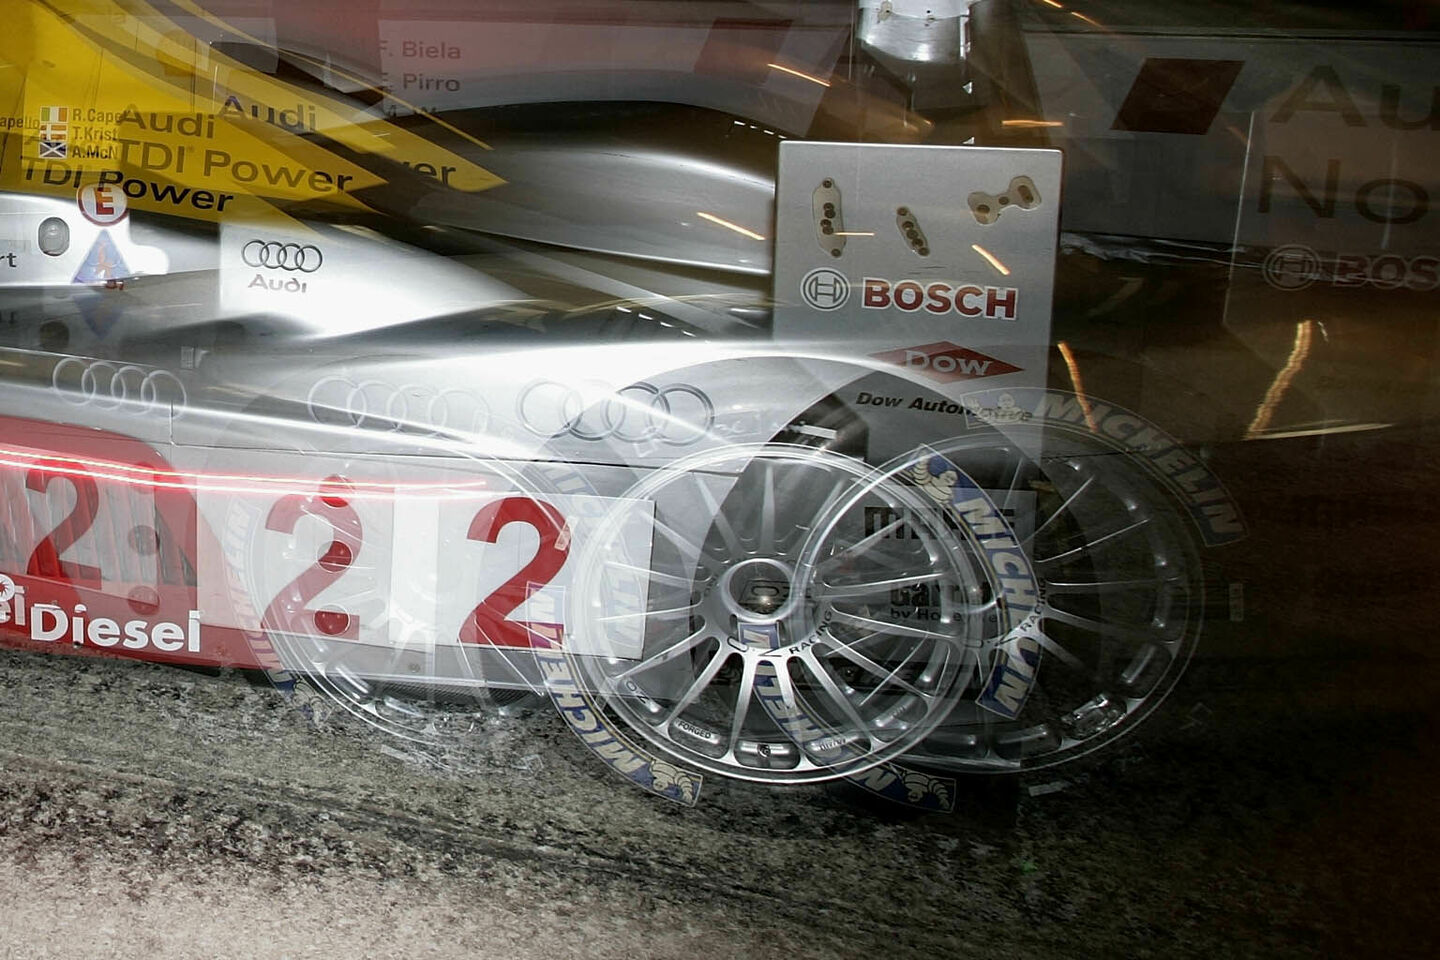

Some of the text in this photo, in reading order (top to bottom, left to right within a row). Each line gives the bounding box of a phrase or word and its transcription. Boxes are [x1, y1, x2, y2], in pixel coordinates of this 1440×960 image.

[402, 41, 461, 59] Biela
[403, 73, 461, 92] Pirro
[117, 103, 216, 139] Audi
[99, 170, 234, 212] Power
[203, 148, 353, 195] Power
[862, 277, 1018, 320] BOSCH
[856, 391, 903, 408] Dow
[24, 454, 103, 590] 2
[261, 493, 363, 641] 2
[459, 496, 573, 649] 2
[30, 603, 201, 653] Diesel
[789, 608, 834, 655] RACING
[677, 721, 713, 739] FORGED
